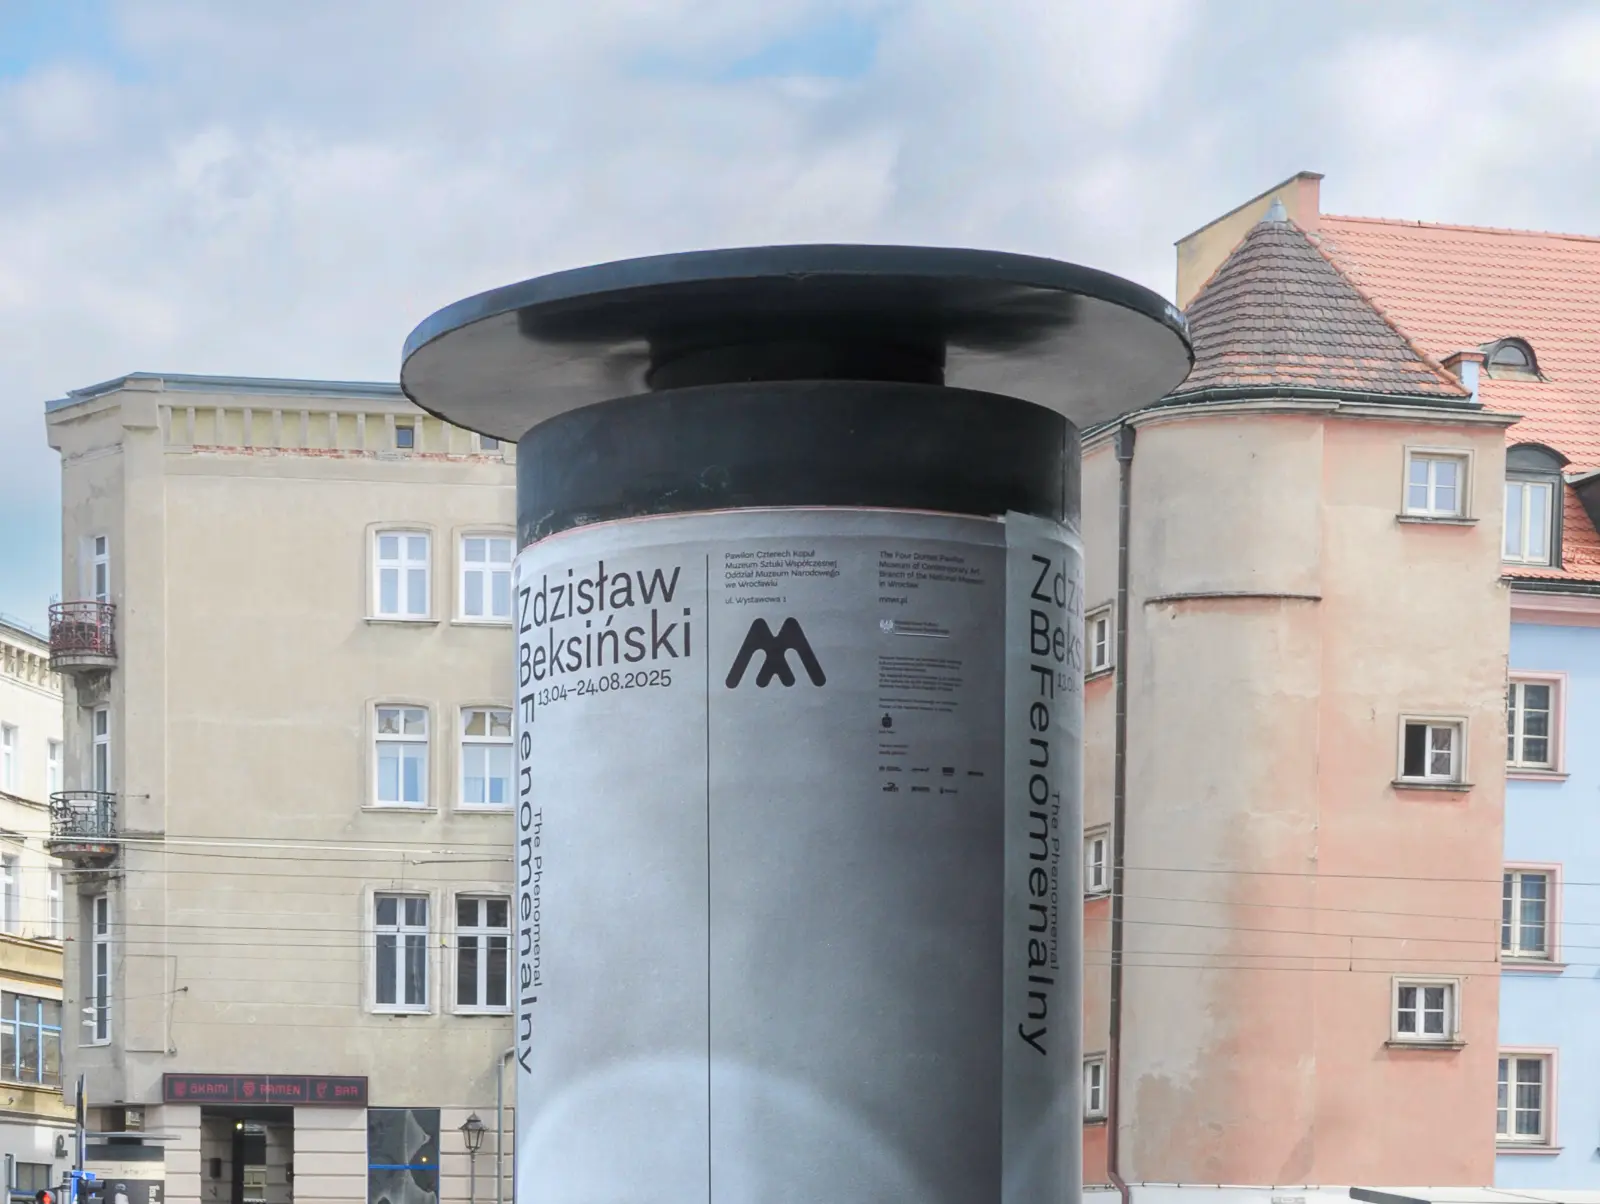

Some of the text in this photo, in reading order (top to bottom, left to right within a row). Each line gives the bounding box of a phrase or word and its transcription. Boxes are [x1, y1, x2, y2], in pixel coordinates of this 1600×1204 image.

[755, 570, 789, 578] Muzeum
[756, 550, 790, 558] Czterech
[760, 560, 783, 568] Sztuki
[519, 560, 681, 634] Zdzisław
[520, 607, 691, 687] Beksiński
[518, 693, 537, 1074] Fenomenalny
[1019, 664, 1054, 1056] Fenomenalny
[533, 808, 543, 987] The Phenomenal
[335, 1085, 359, 1096] BAR
